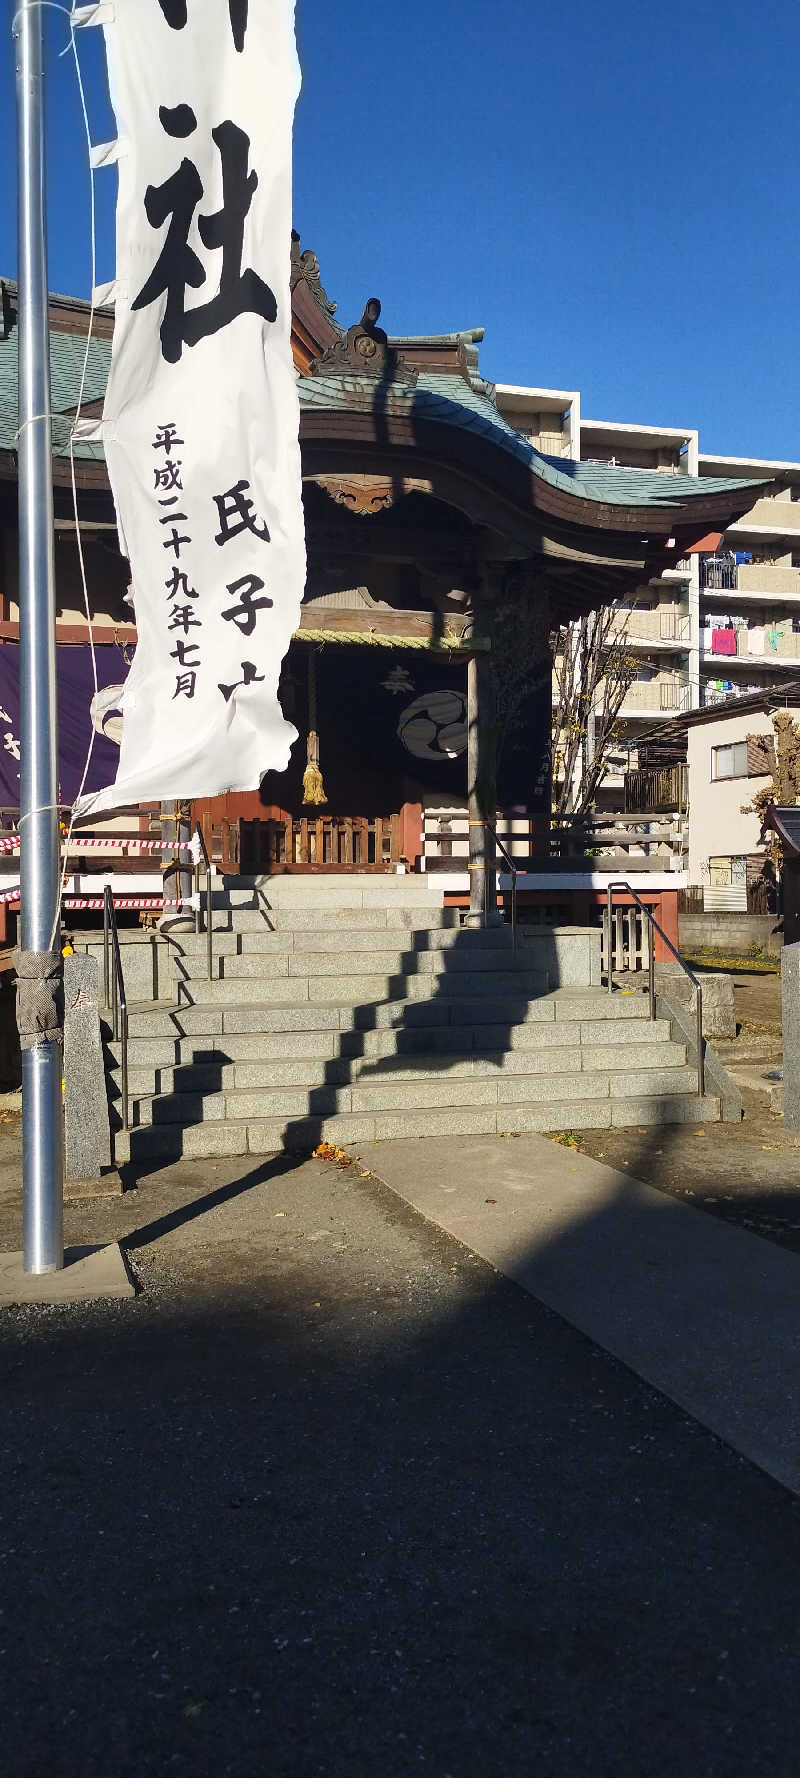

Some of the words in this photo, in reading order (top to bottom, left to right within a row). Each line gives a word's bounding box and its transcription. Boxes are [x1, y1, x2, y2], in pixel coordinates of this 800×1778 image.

[131, 0, 277, 363] 社
[152, 423, 201, 699] 平成二十九年七月
[376, 664, 416, 696] 奉
